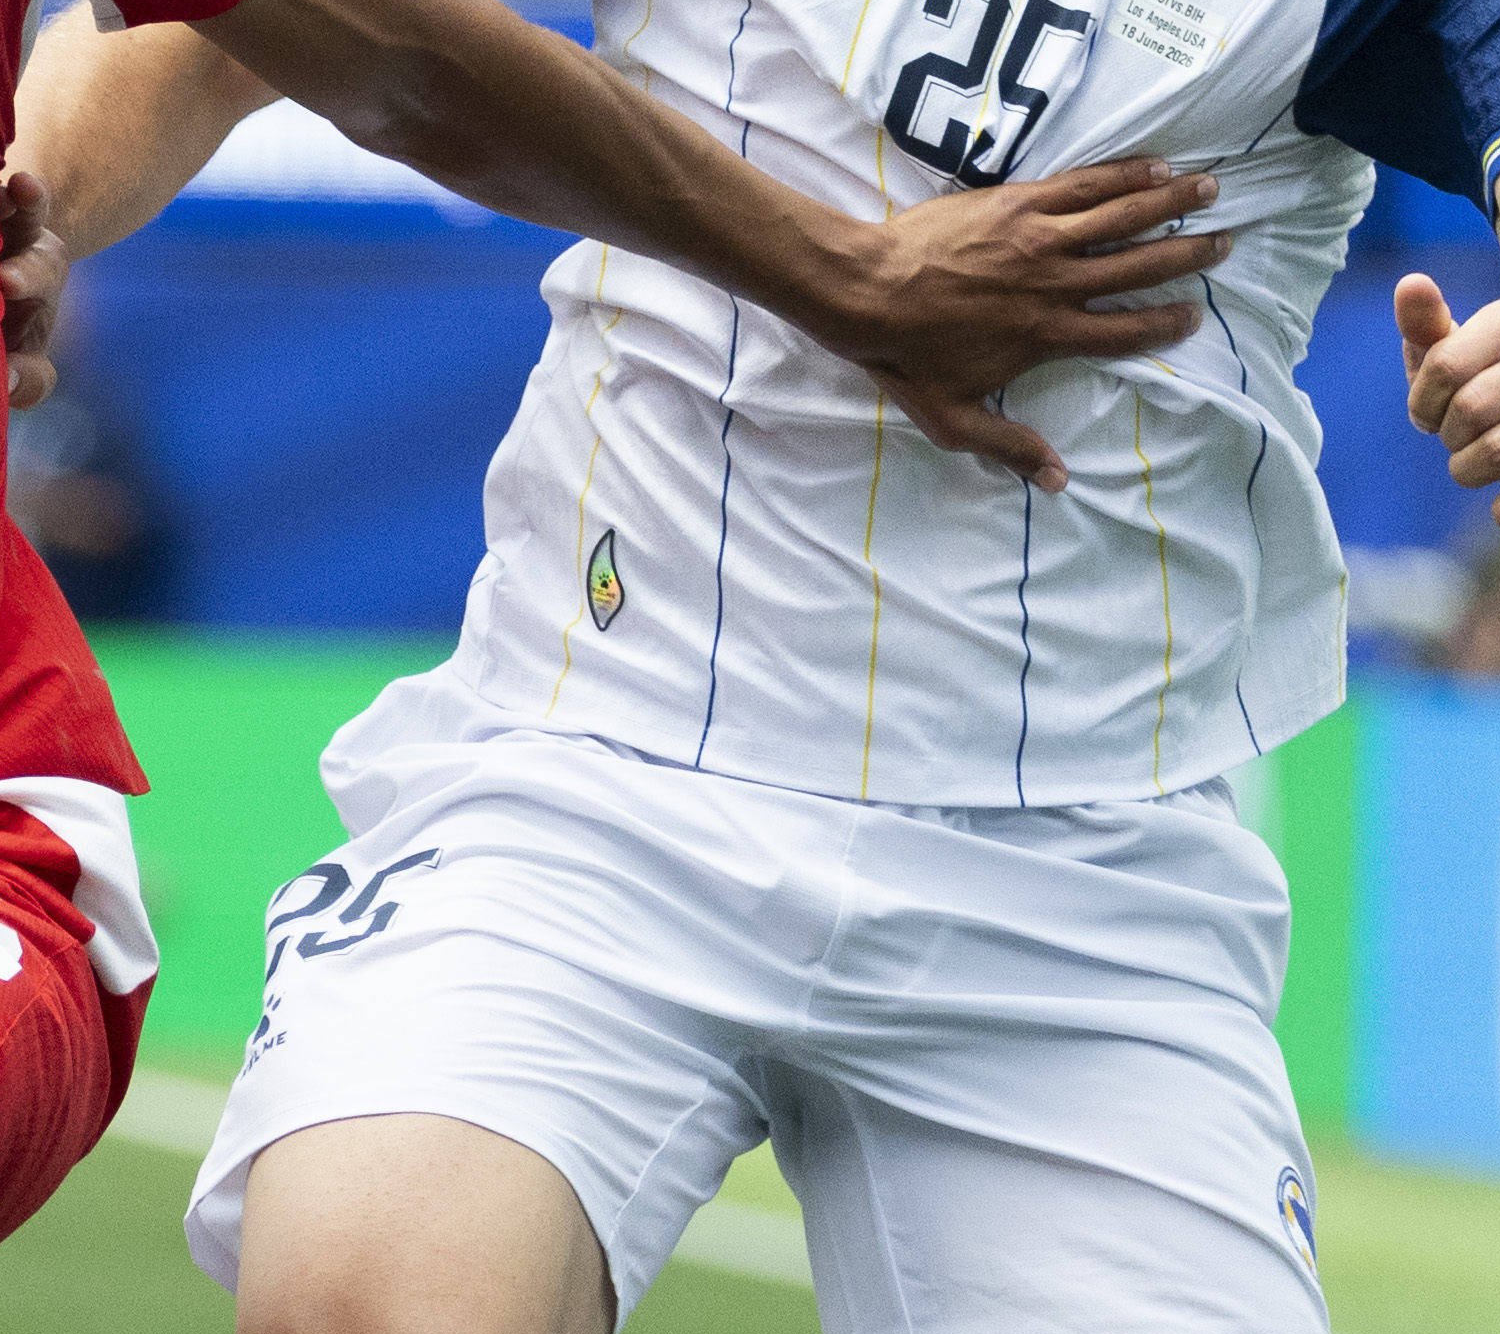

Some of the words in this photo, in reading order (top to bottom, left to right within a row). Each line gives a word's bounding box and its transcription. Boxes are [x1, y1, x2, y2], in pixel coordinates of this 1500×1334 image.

[1126, 0, 1144, 18] Los
[1182, 29, 1206, 50] USA
[1184, 4, 1205, 24] BIH
[1121, 23, 1137, 39] 18
[1136, 32, 1165, 55] June
[1165, 46, 1194, 68] 2026
